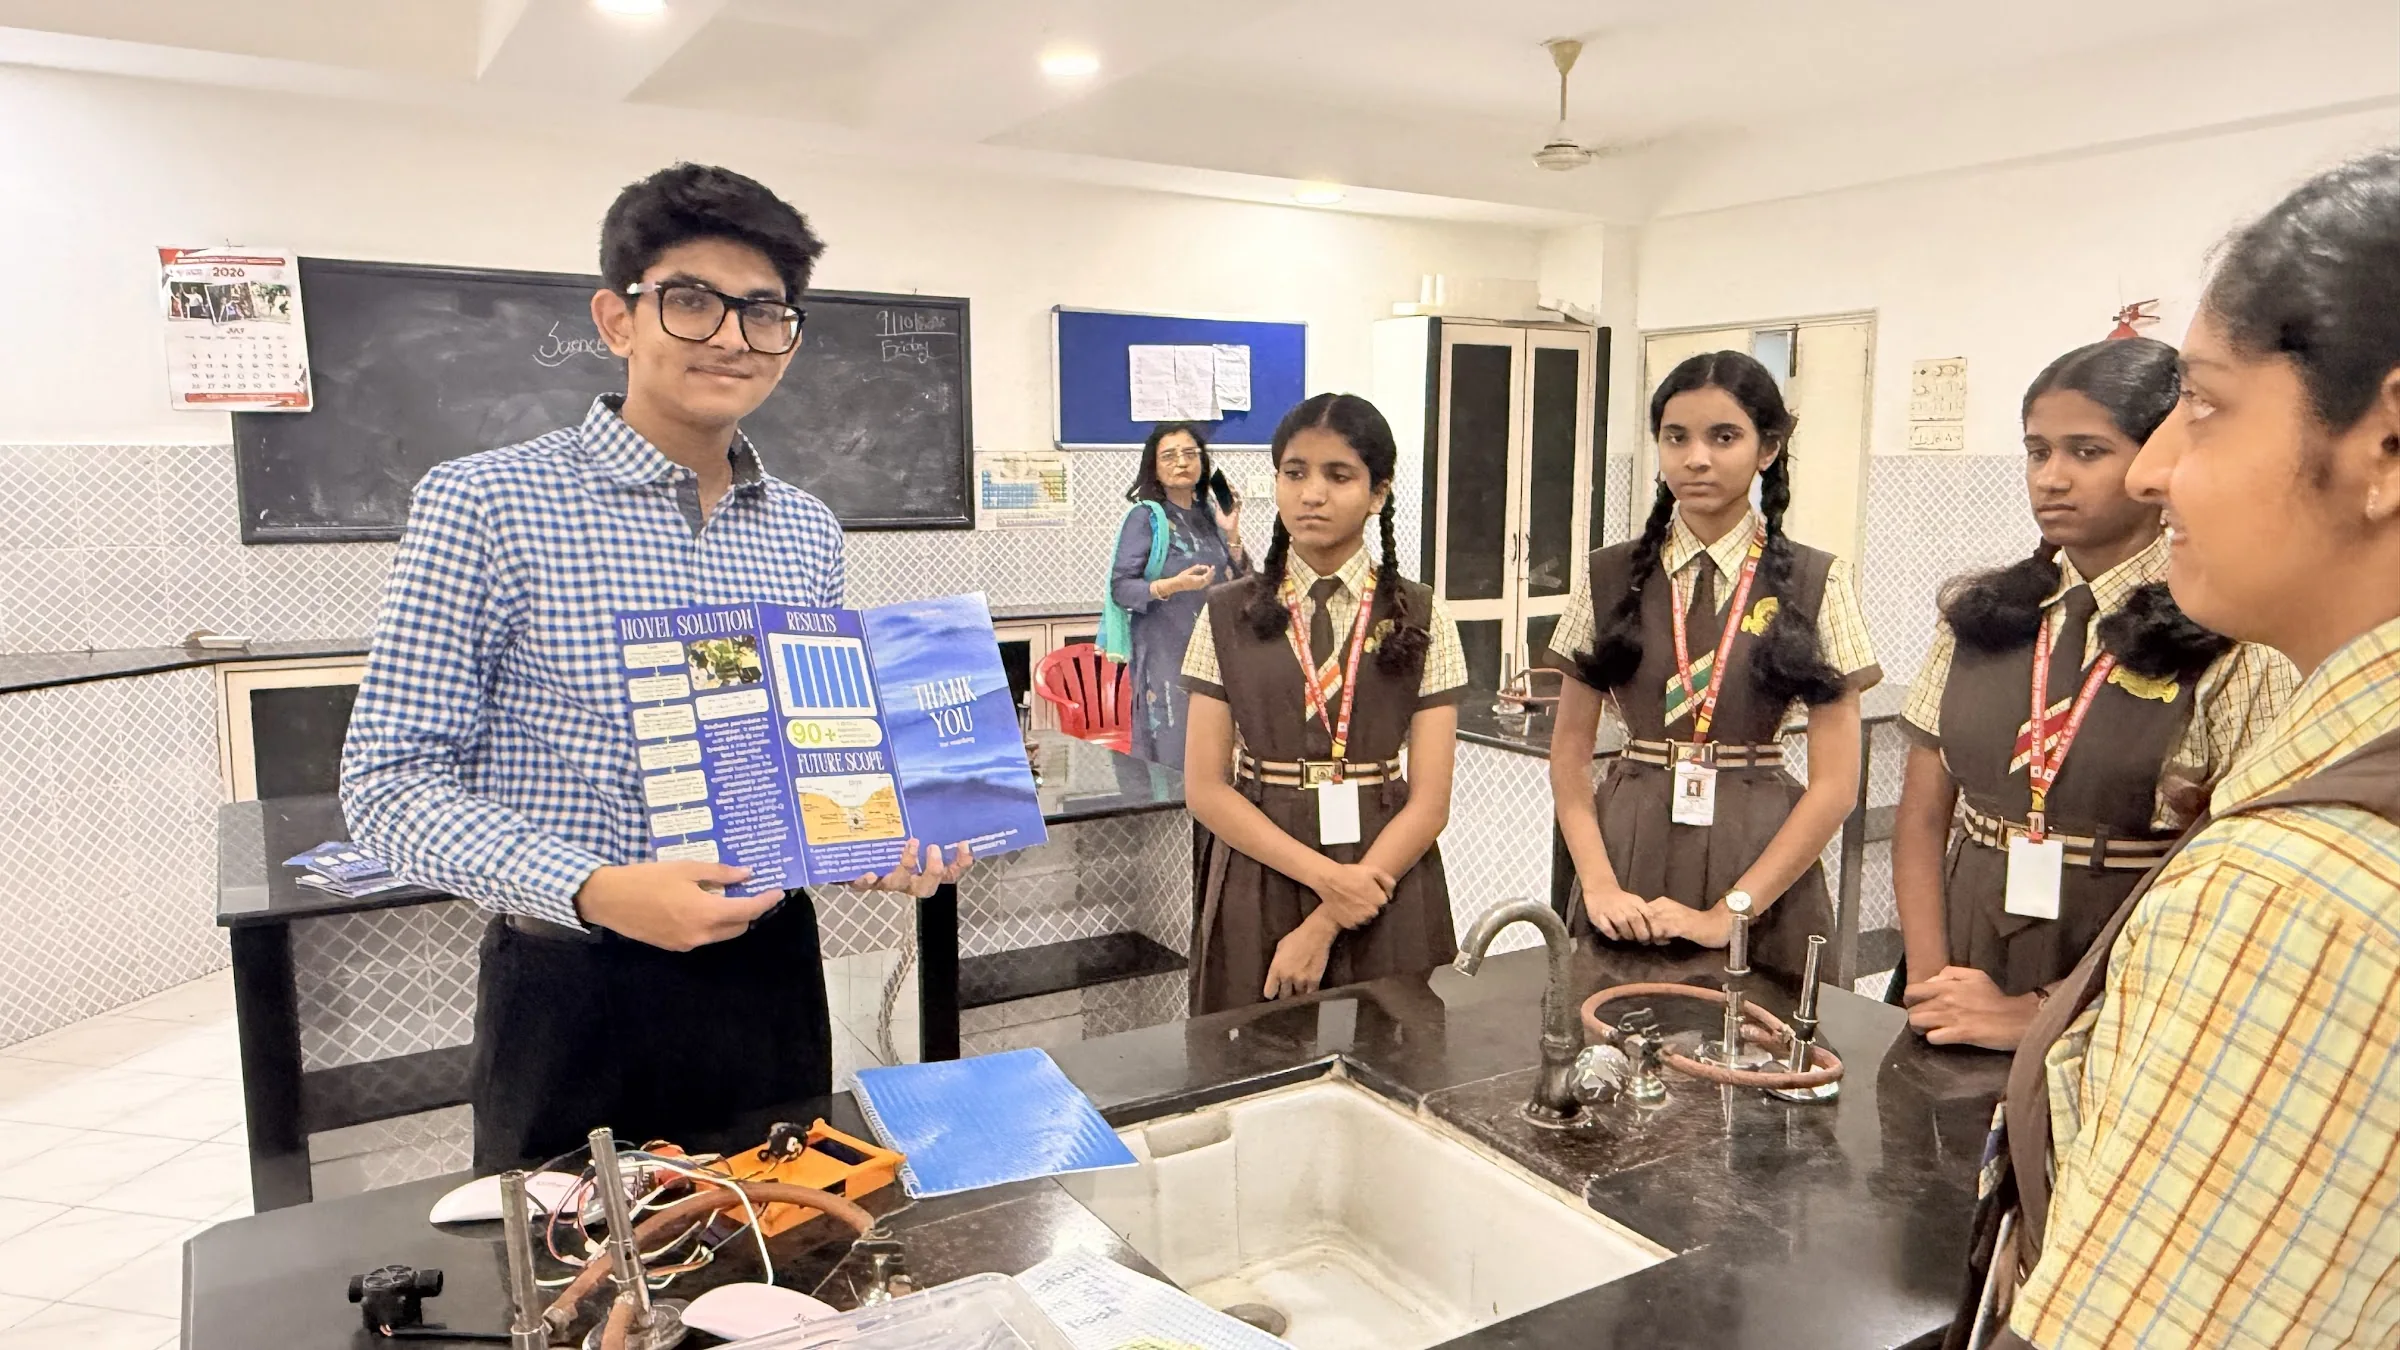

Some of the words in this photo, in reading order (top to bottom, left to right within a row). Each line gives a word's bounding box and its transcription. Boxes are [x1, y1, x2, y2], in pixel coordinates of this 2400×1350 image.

[212, 267, 245, 277] 2026
[621, 616, 673, 640] NOVEL
[676, 608, 754, 636] SOLUTION
[786, 611, 837, 633] RESULTS
[912, 675, 977, 711] THANK
[930, 705, 973, 738] YOU
[796, 752, 844, 774] FUTURE
[844, 751, 885, 772] SCOPE
